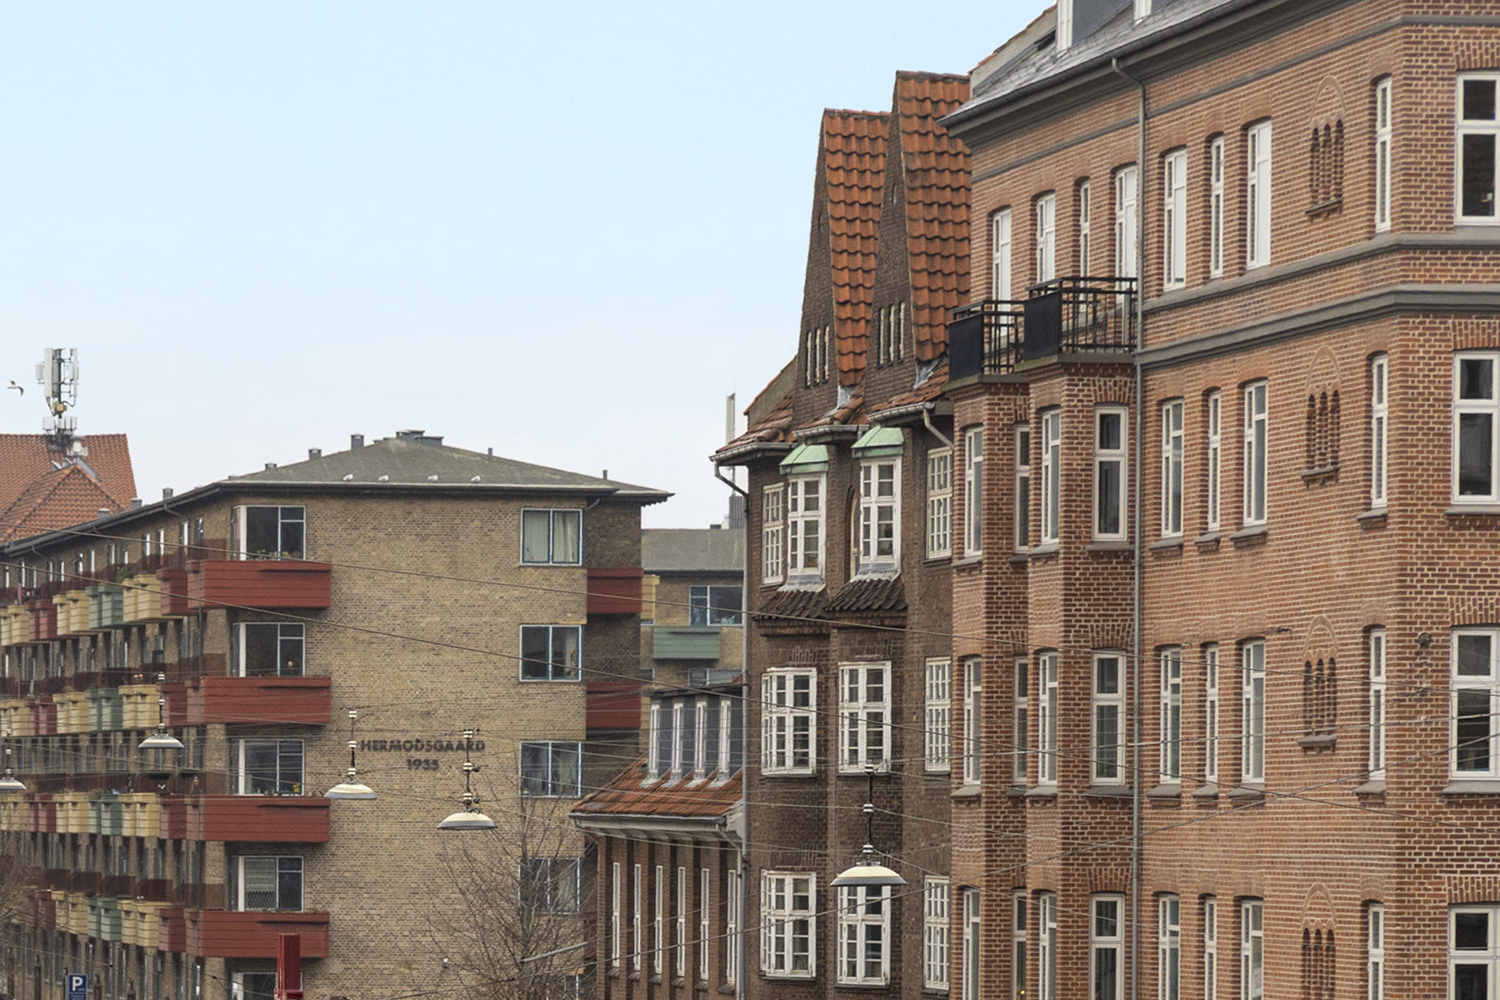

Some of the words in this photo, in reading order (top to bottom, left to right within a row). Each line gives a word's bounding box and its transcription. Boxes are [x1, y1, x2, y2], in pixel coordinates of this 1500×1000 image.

[360, 740, 485, 752] HERMODSGAARD
[407, 759, 439, 771] 1935
[72, 976, 83, 991] P
